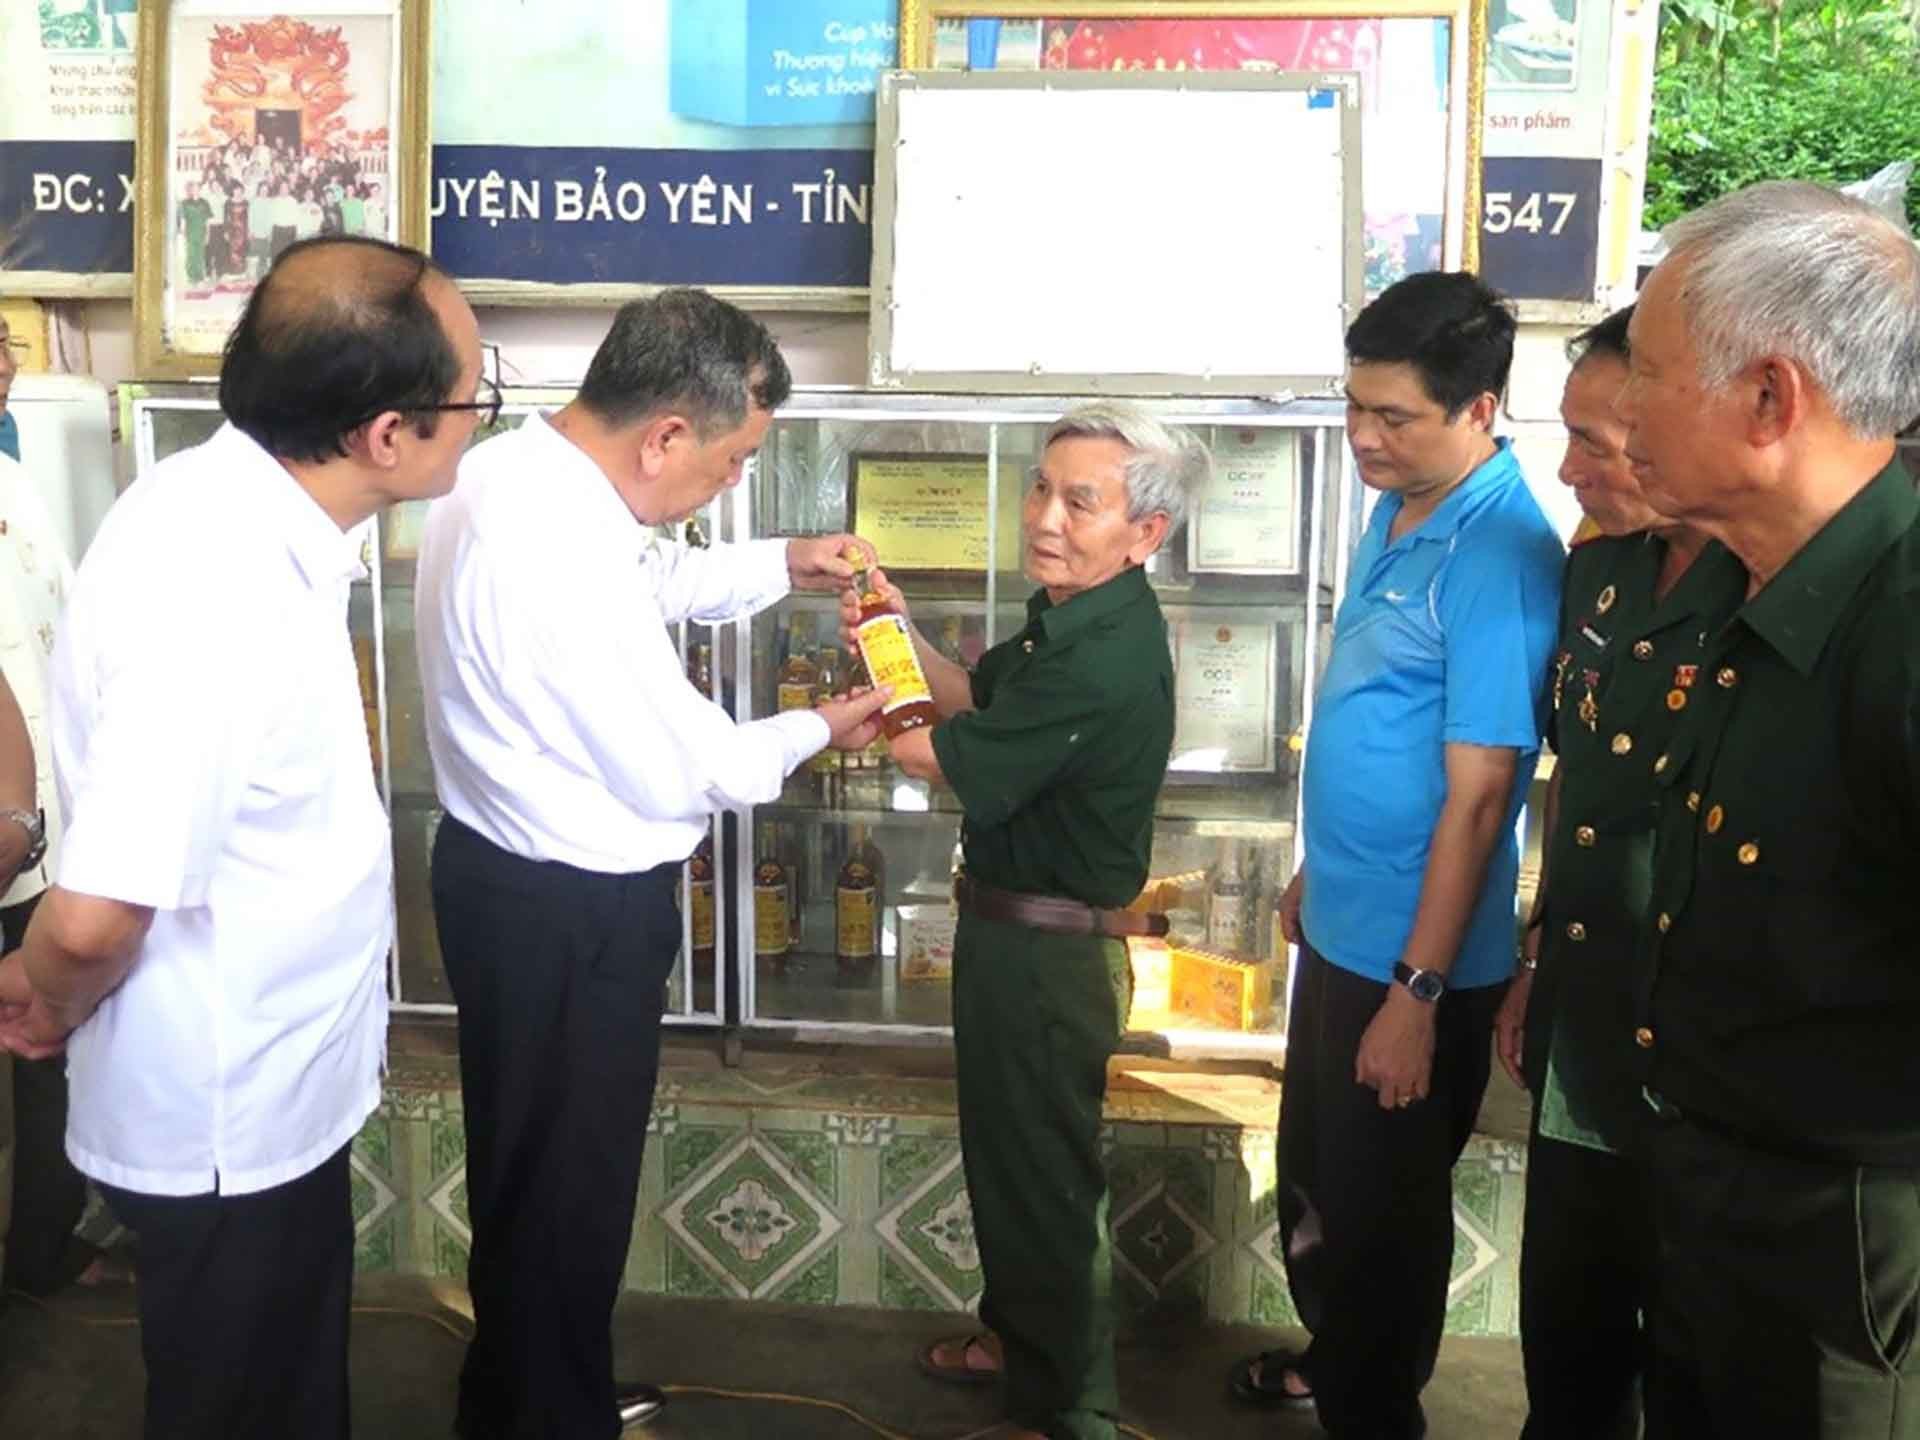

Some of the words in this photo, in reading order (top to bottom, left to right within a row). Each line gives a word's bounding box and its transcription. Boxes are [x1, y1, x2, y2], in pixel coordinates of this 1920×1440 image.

[33, 173, 105, 213] ĐC:
[554, 166, 648, 222] BẢO
[659, 173, 753, 225] YÊN
[765, 201, 780, 212] -
[1483, 191, 1577, 236] 547
